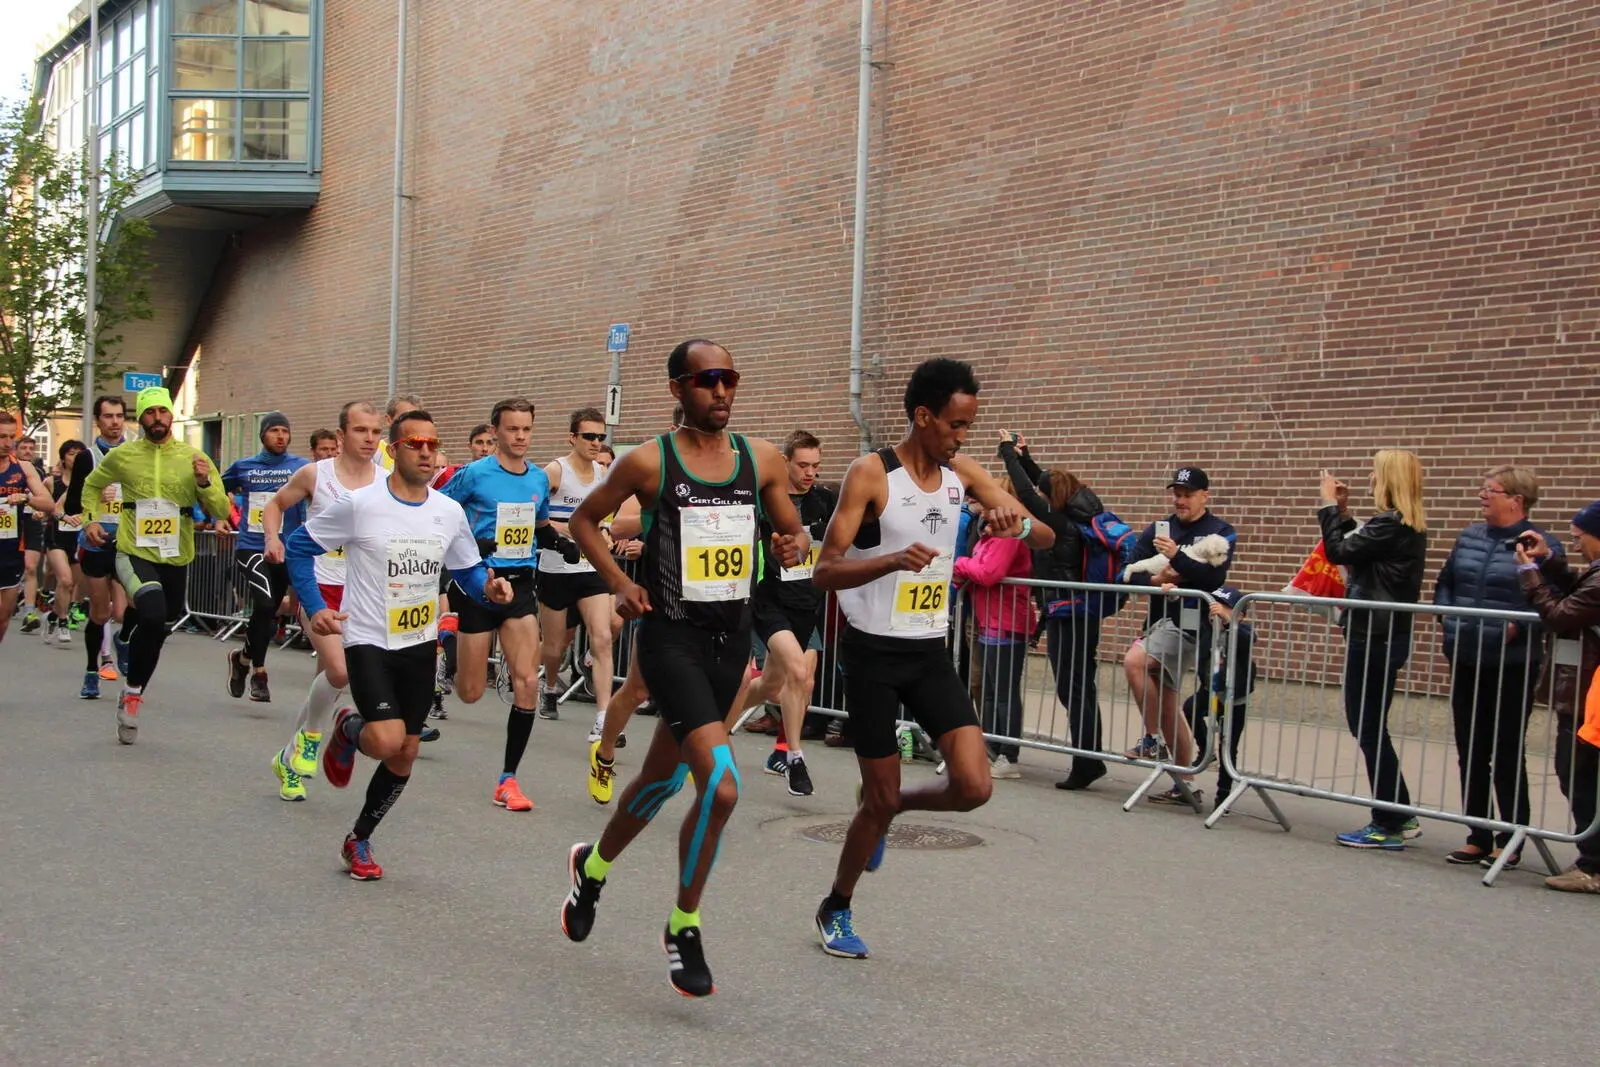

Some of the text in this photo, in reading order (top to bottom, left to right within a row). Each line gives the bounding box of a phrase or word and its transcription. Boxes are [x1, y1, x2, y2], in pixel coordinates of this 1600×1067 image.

[130, 376, 156, 389] Taxi
[144, 519, 172, 535] 222
[504, 528, 529, 545] 632
[698, 547, 743, 577] 189
[909, 585, 943, 610] 126
[397, 605, 430, 629] 403
